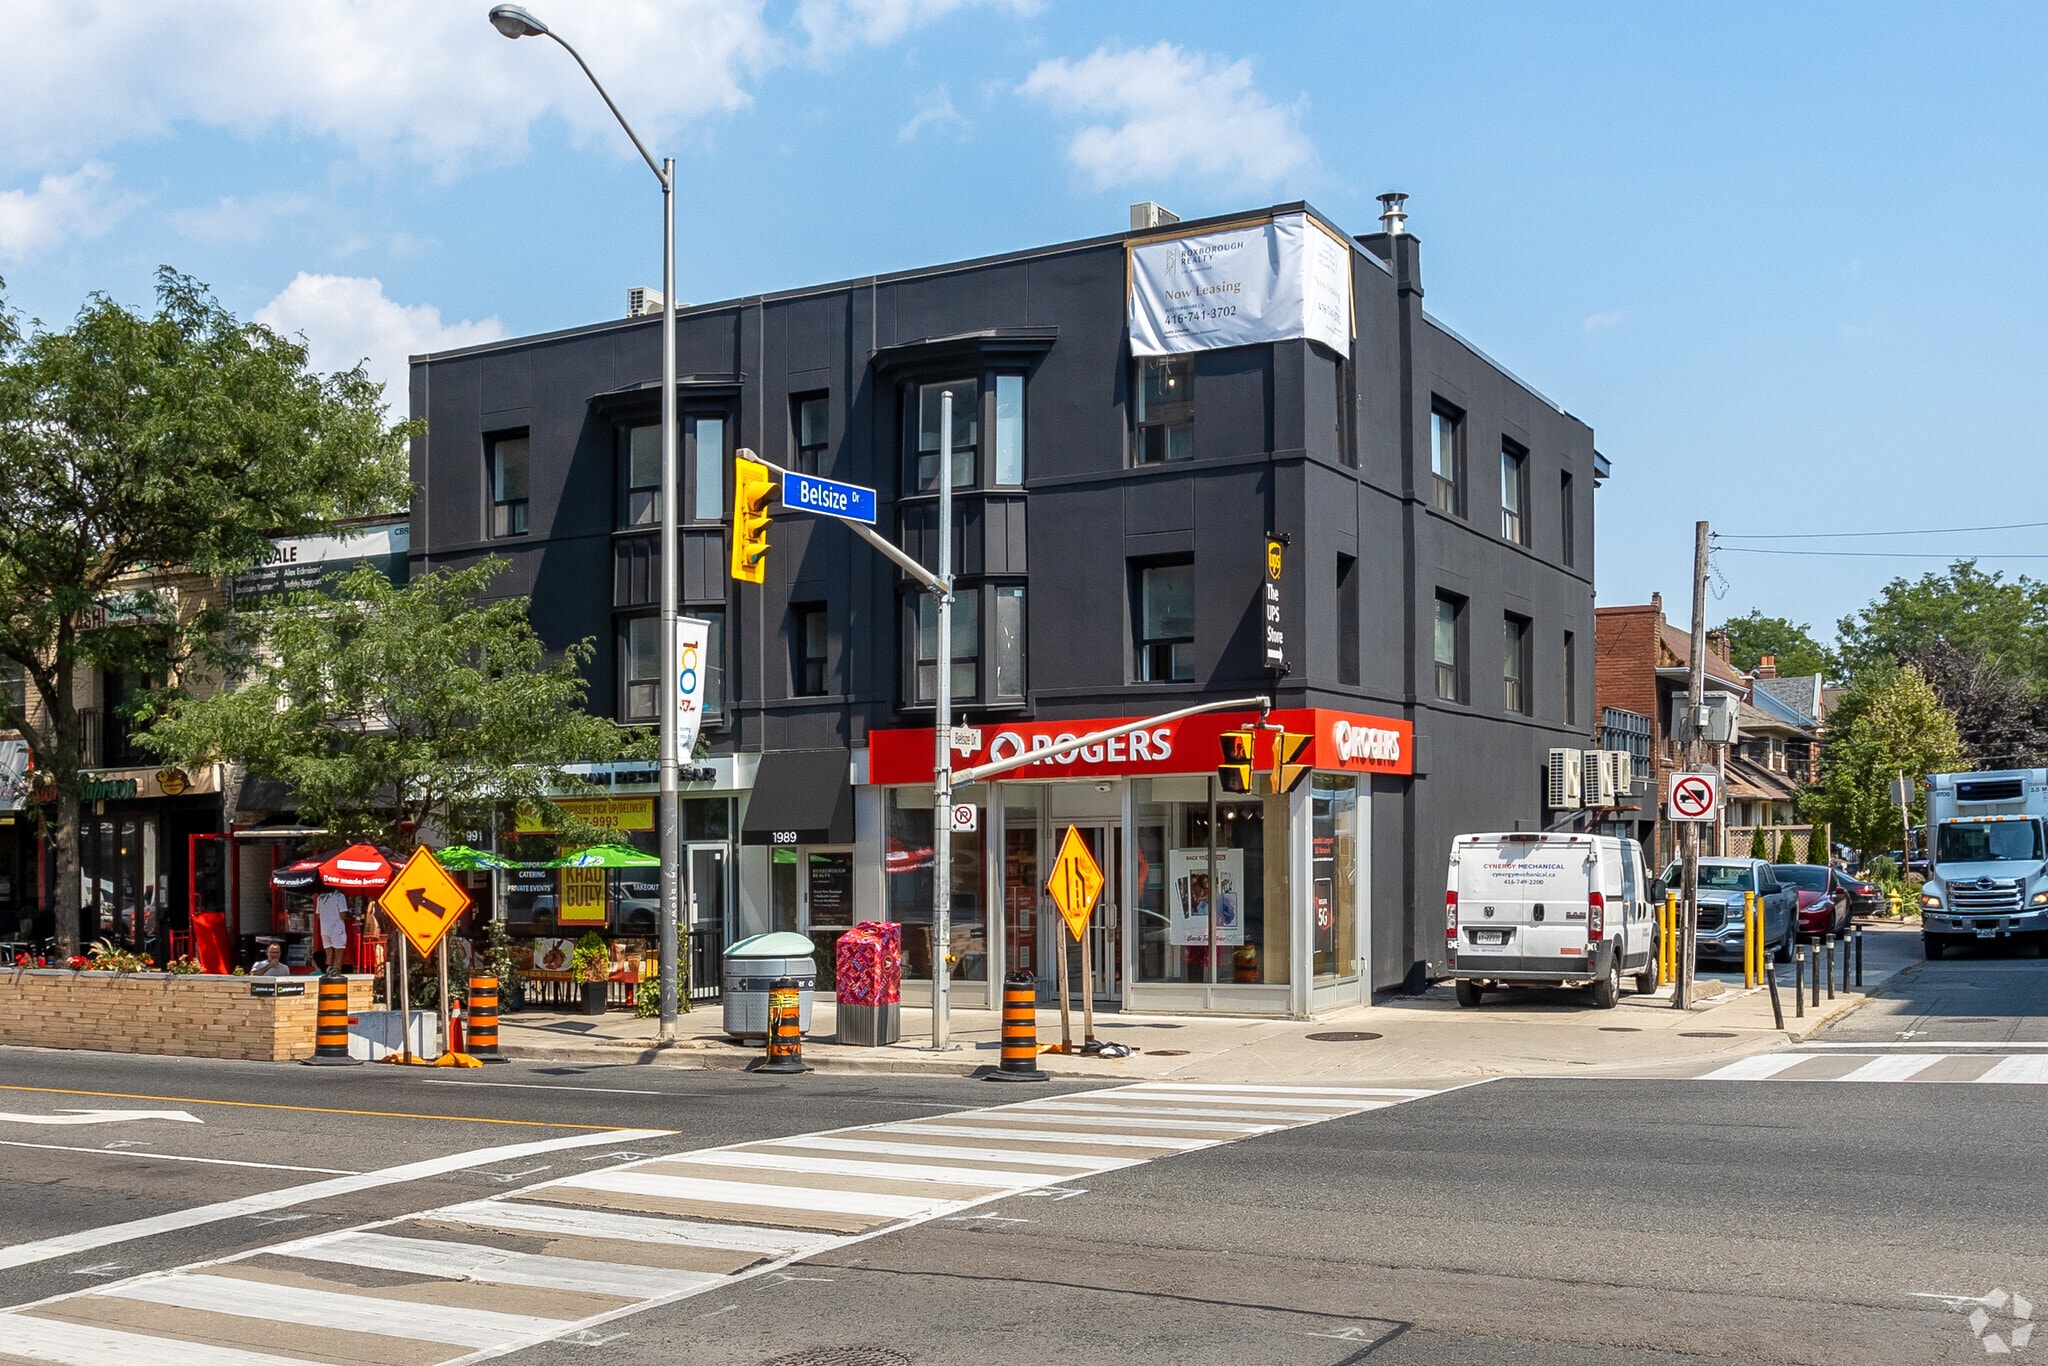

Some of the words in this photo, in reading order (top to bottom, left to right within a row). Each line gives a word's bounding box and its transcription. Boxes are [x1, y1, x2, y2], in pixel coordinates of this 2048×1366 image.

[1181, 241, 1244, 258] ROXBOROUGH
[1181, 254, 1214, 266] REALTY
[1164, 289, 1192, 301] Now
[1196, 281, 1241, 297] Leasing
[1164, 305, 1237, 325] 416-741-3702
[800, 480, 848, 511] Belsize
[852, 491, 860, 504] Dr
[394, 527, 409, 536] CBR
[1269, 553, 1281, 573] ups
[283, 568, 296, 577] Alex
[1266, 583, 1279, 601] The
[1266, 604, 1280, 622] UPS
[1267, 625, 1283, 644] Store
[954, 731, 970, 747] Belsize
[971, 733, 977, 746] Dr
[1032, 728, 1172, 766] ROGERS
[593, 803, 607, 814] PICK
[772, 831, 797, 843] 1989
[323, 874, 340, 882] Beer
[340, 877, 362, 885] made
[507, 884, 529, 892] PRIVATE
[529, 884, 551, 892] EVENTS
[566, 885, 602, 907] GULLY
[1317, 907, 1328, 926] 5G
